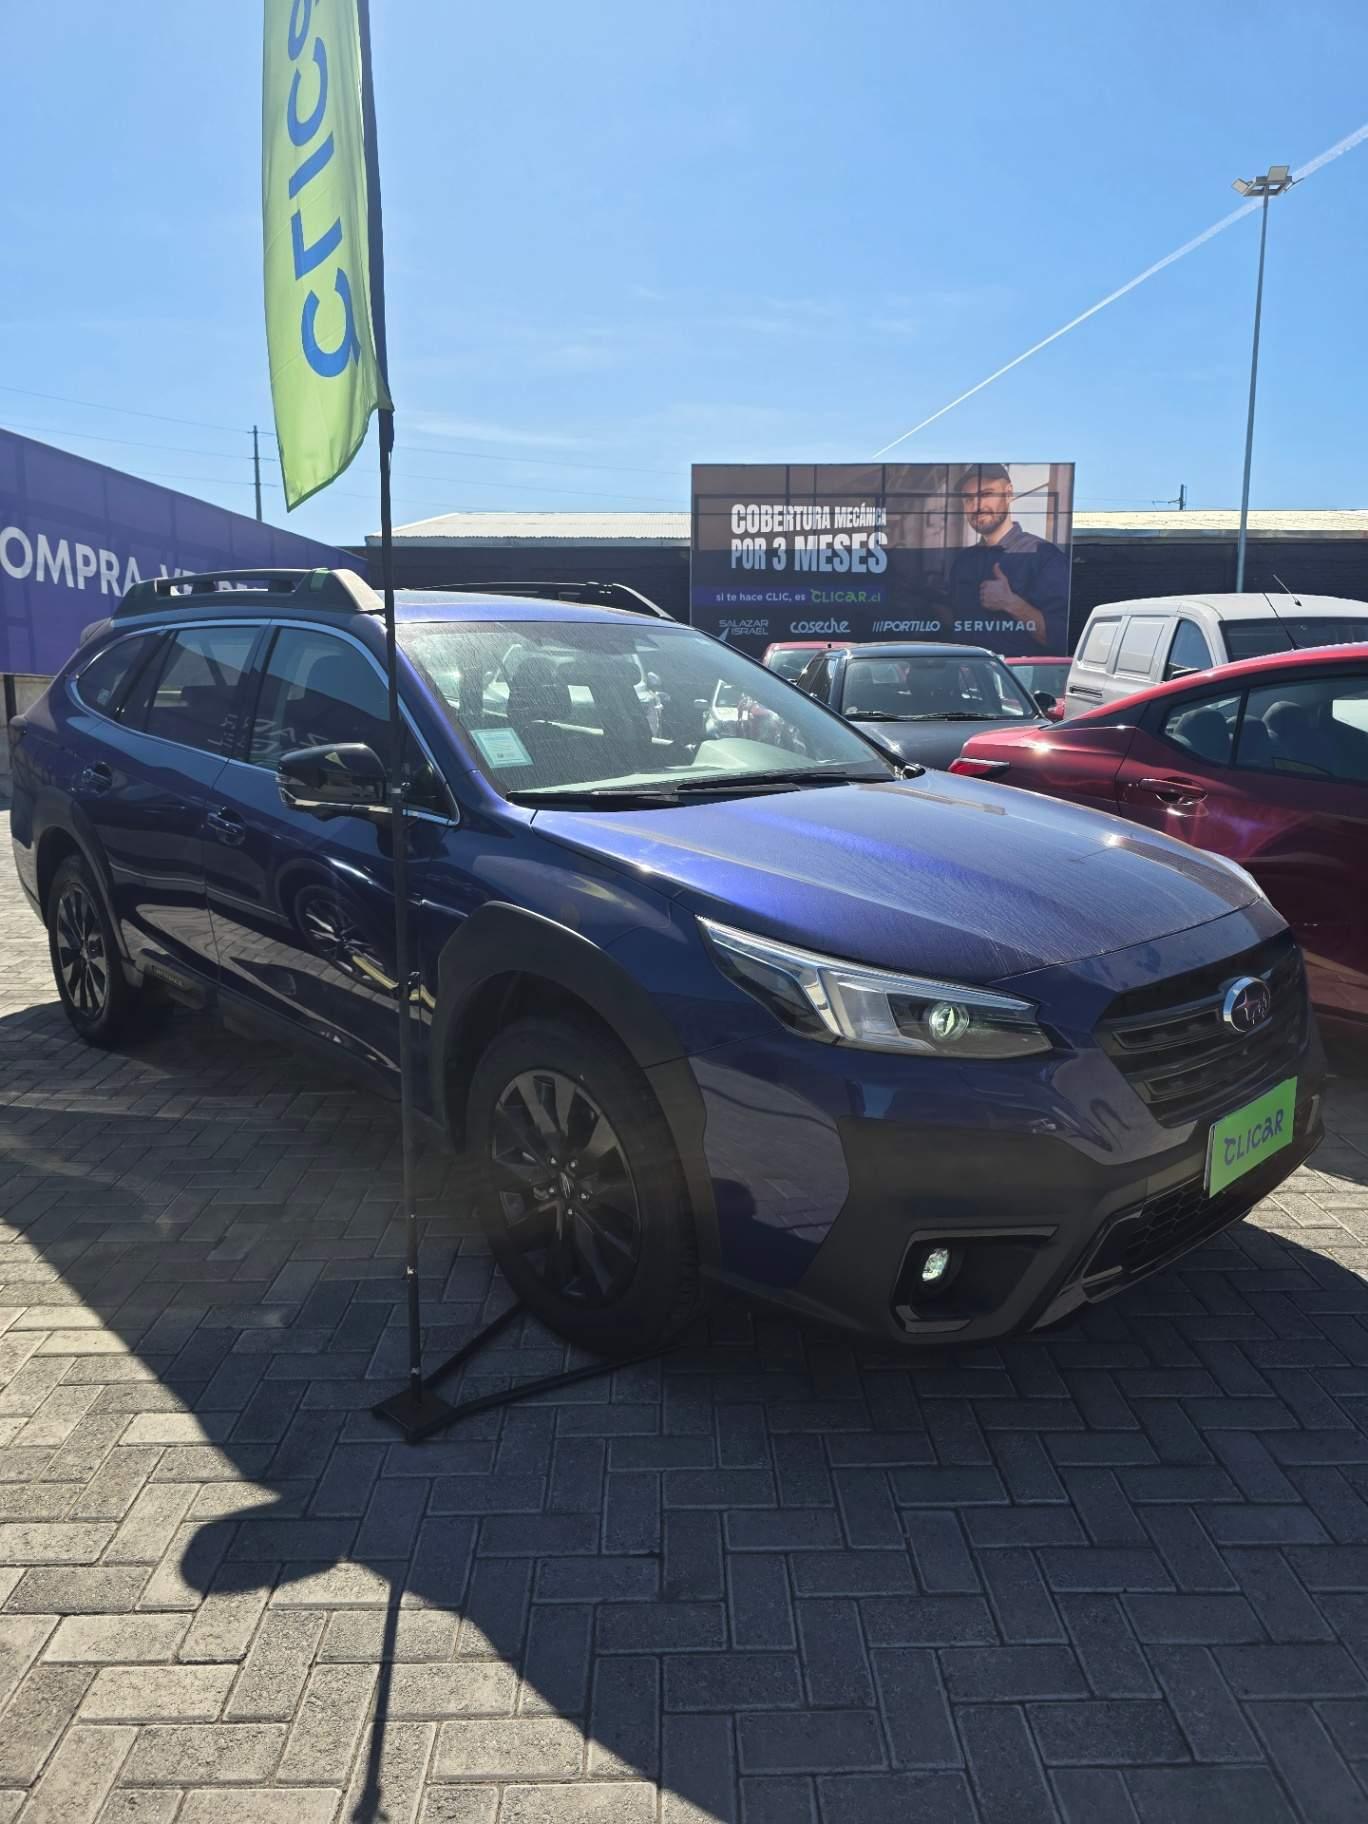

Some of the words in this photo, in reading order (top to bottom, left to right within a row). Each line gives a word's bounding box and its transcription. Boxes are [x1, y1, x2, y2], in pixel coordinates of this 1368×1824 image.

[731, 503, 830, 534] COBERTURA
[834, 502, 887, 529] MECÁNICA
[731, 537, 767, 570] POR
[772, 536, 787, 571] 3
[794, 532, 888, 573] MESES
[716, 592, 724, 601] si
[727, 592, 737, 601] te
[740, 592, 763, 601] hace
[766, 592, 792, 602] CLIC,
[719, 619, 769, 628] SALAZAR
[790, 617, 851, 634] coseche
[954, 620, 1037, 632] SERVIMAQ
